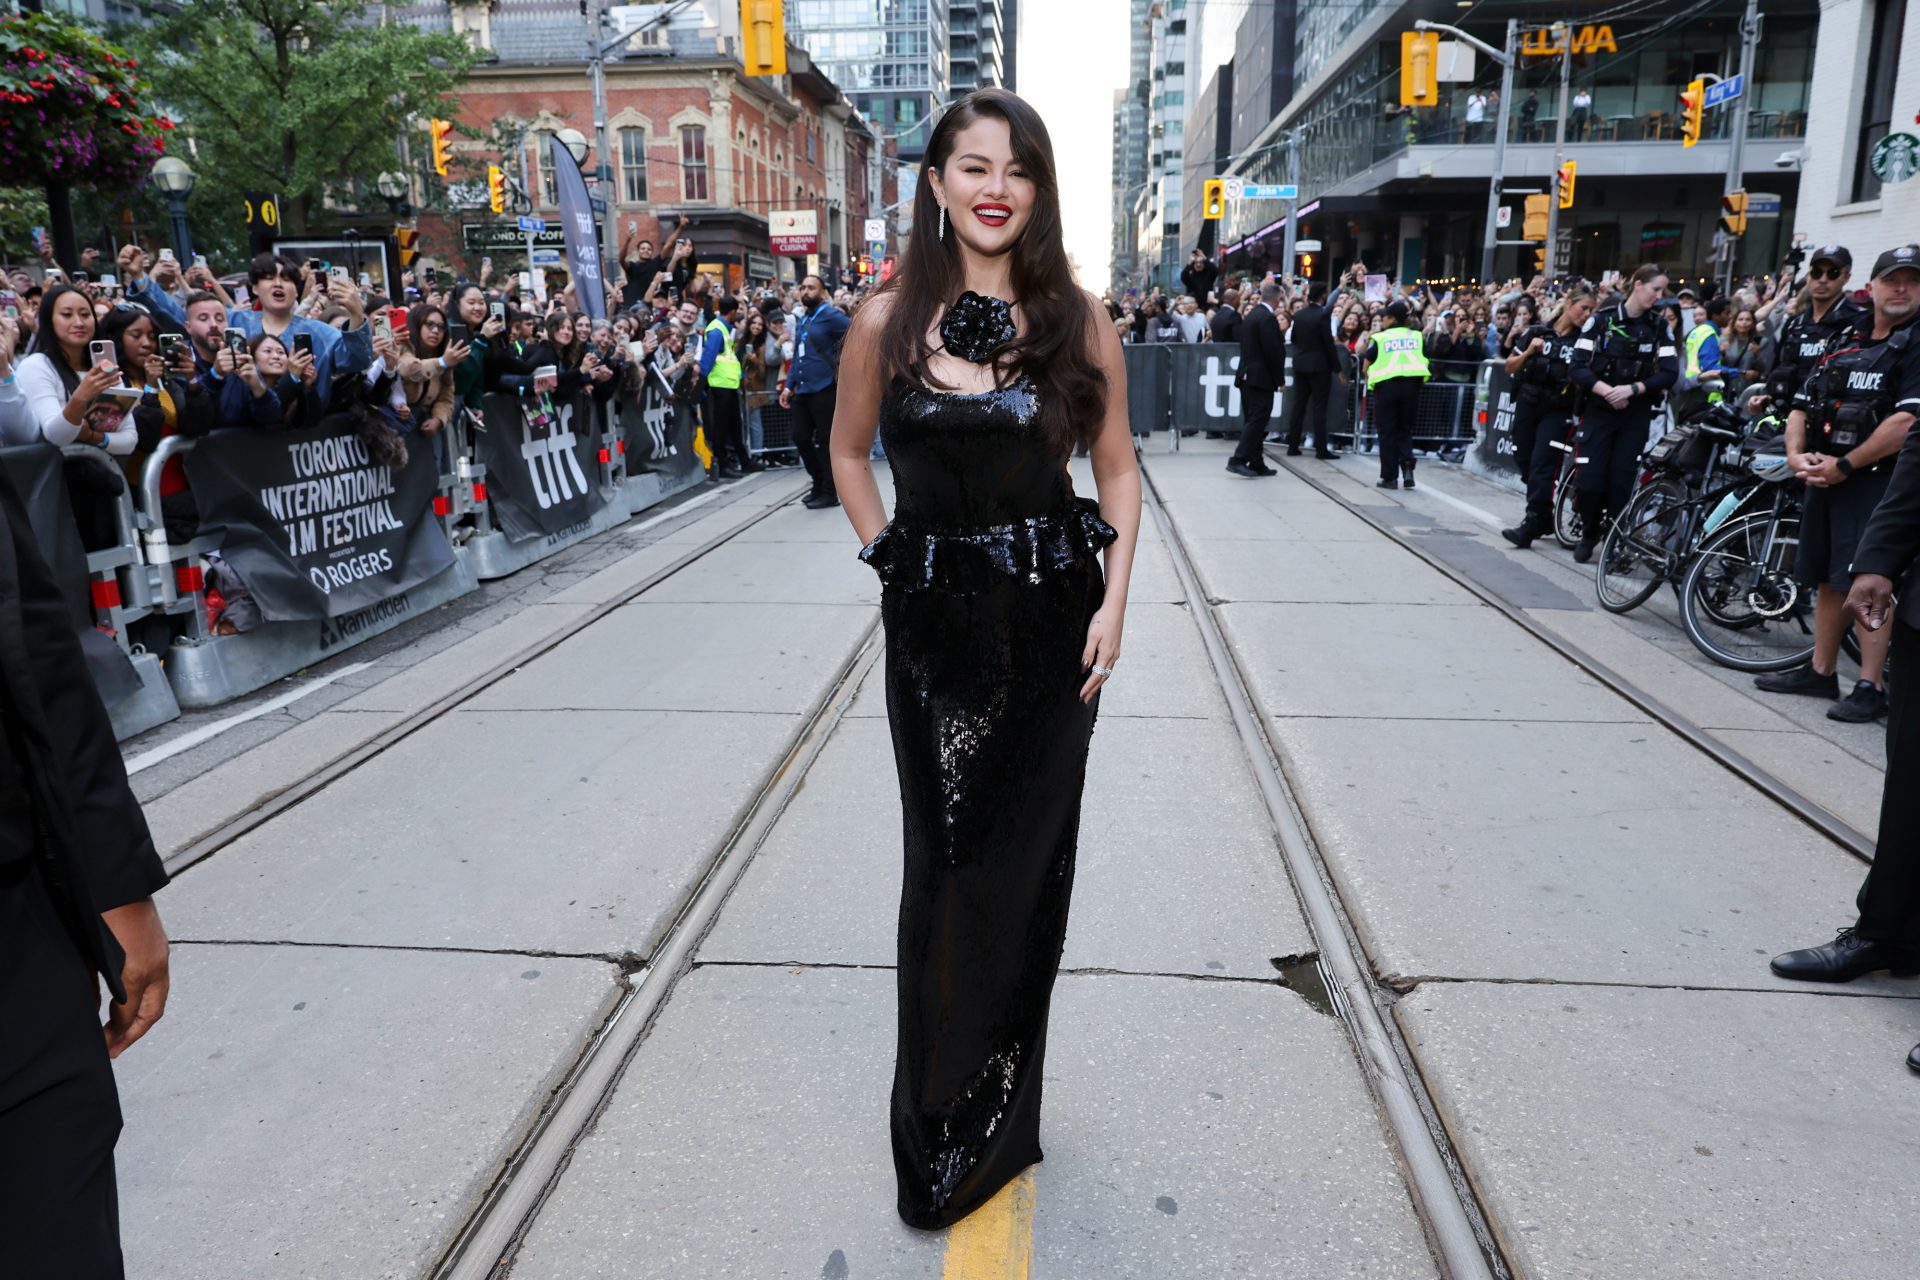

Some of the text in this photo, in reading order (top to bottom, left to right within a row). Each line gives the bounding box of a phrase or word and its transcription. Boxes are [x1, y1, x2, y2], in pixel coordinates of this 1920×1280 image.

[1256, 187, 1277, 196] John
[539, 230, 564, 241] COFF
[789, 235, 816, 243] INDIAN
[1384, 338, 1419, 352] POLICE
[1199, 356, 1294, 417] tif
[1847, 371, 1883, 390] POLICE
[288, 434, 369, 479] TORONTO
[261, 466, 395, 520] INTERNATIONAL
[322, 500, 403, 548] FESTIVAL
[326, 548, 393, 588] ROGERS
